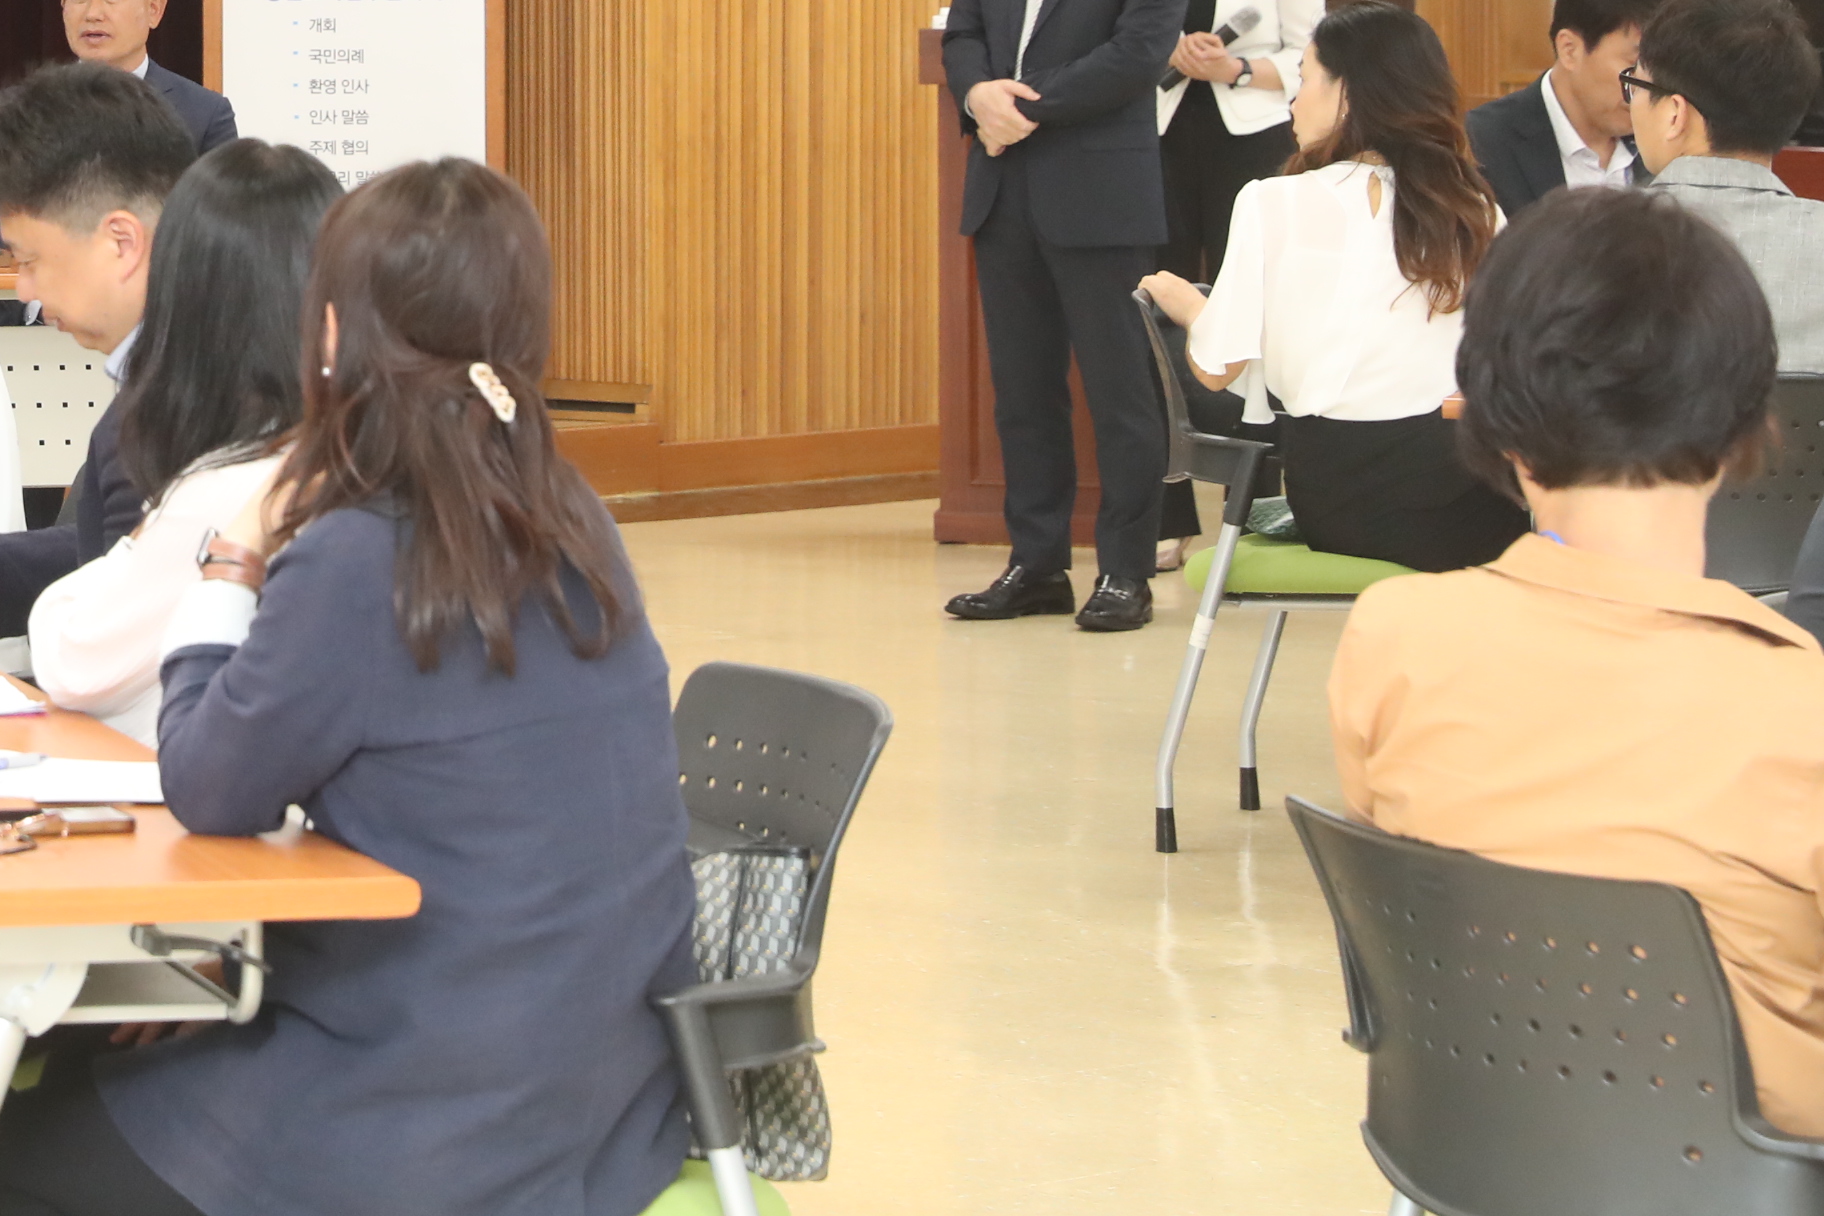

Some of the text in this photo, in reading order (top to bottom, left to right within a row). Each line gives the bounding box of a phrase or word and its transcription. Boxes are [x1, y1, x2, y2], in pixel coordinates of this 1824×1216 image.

[308, 18, 337, 33] 개회
[308, 49, 365, 64] 국민의례
[308, 79, 369, 95] 환영 인사
[308, 109, 369, 125] 인사 말씀
[308, 139, 369, 155] 주제 협의
